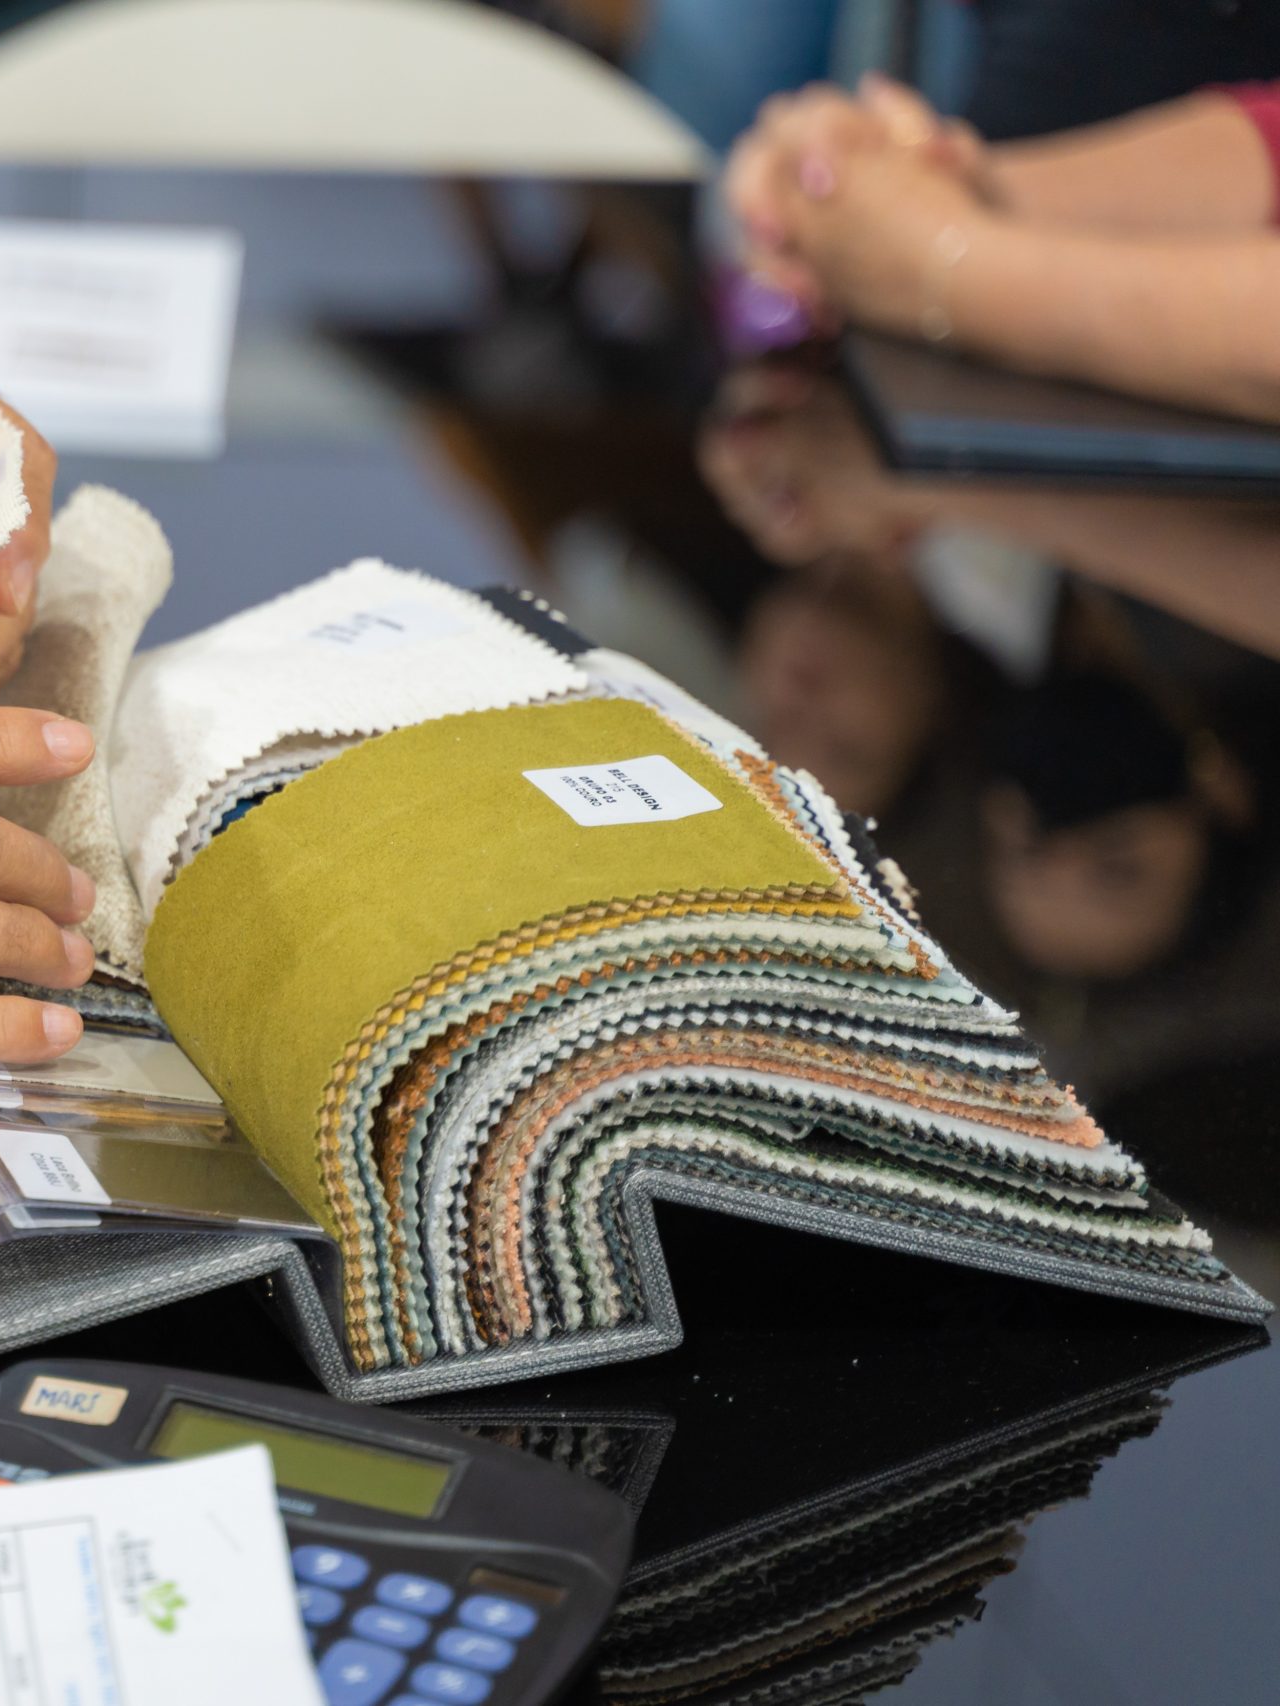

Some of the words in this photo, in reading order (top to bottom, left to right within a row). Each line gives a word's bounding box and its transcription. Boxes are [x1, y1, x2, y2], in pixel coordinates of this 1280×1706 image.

[579, 776, 607, 795] GRUPO
[608, 769, 632, 783] BELL
[627, 783, 662, 811] DESIGN
[576, 787, 602, 807] COURO
